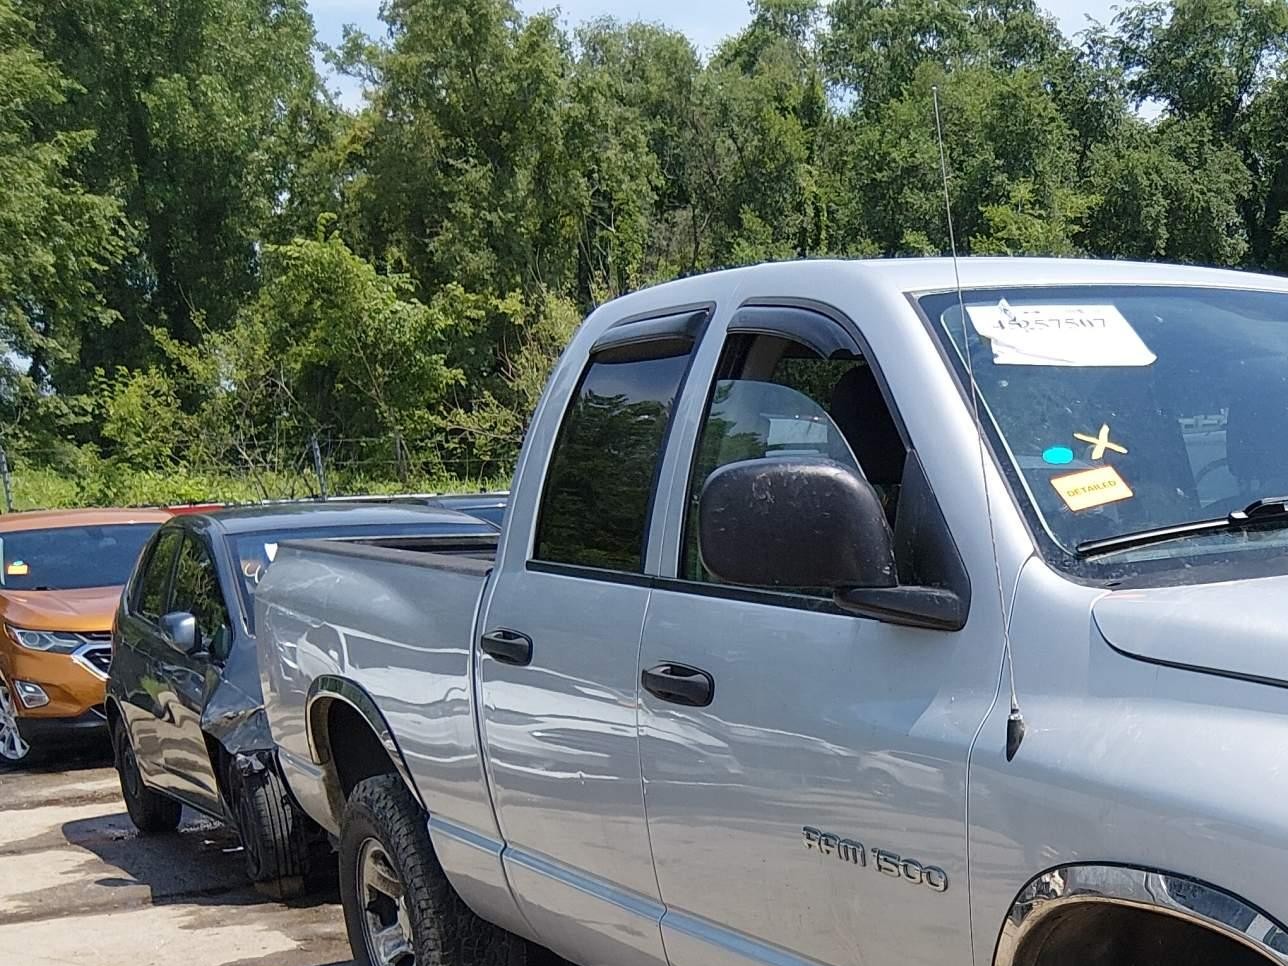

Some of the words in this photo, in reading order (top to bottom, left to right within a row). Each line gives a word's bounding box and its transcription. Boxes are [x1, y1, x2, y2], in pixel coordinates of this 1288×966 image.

[1066, 480, 1117, 497] DETAILED
[801, 825, 867, 867] RAM
[870, 847, 949, 893] 1500
